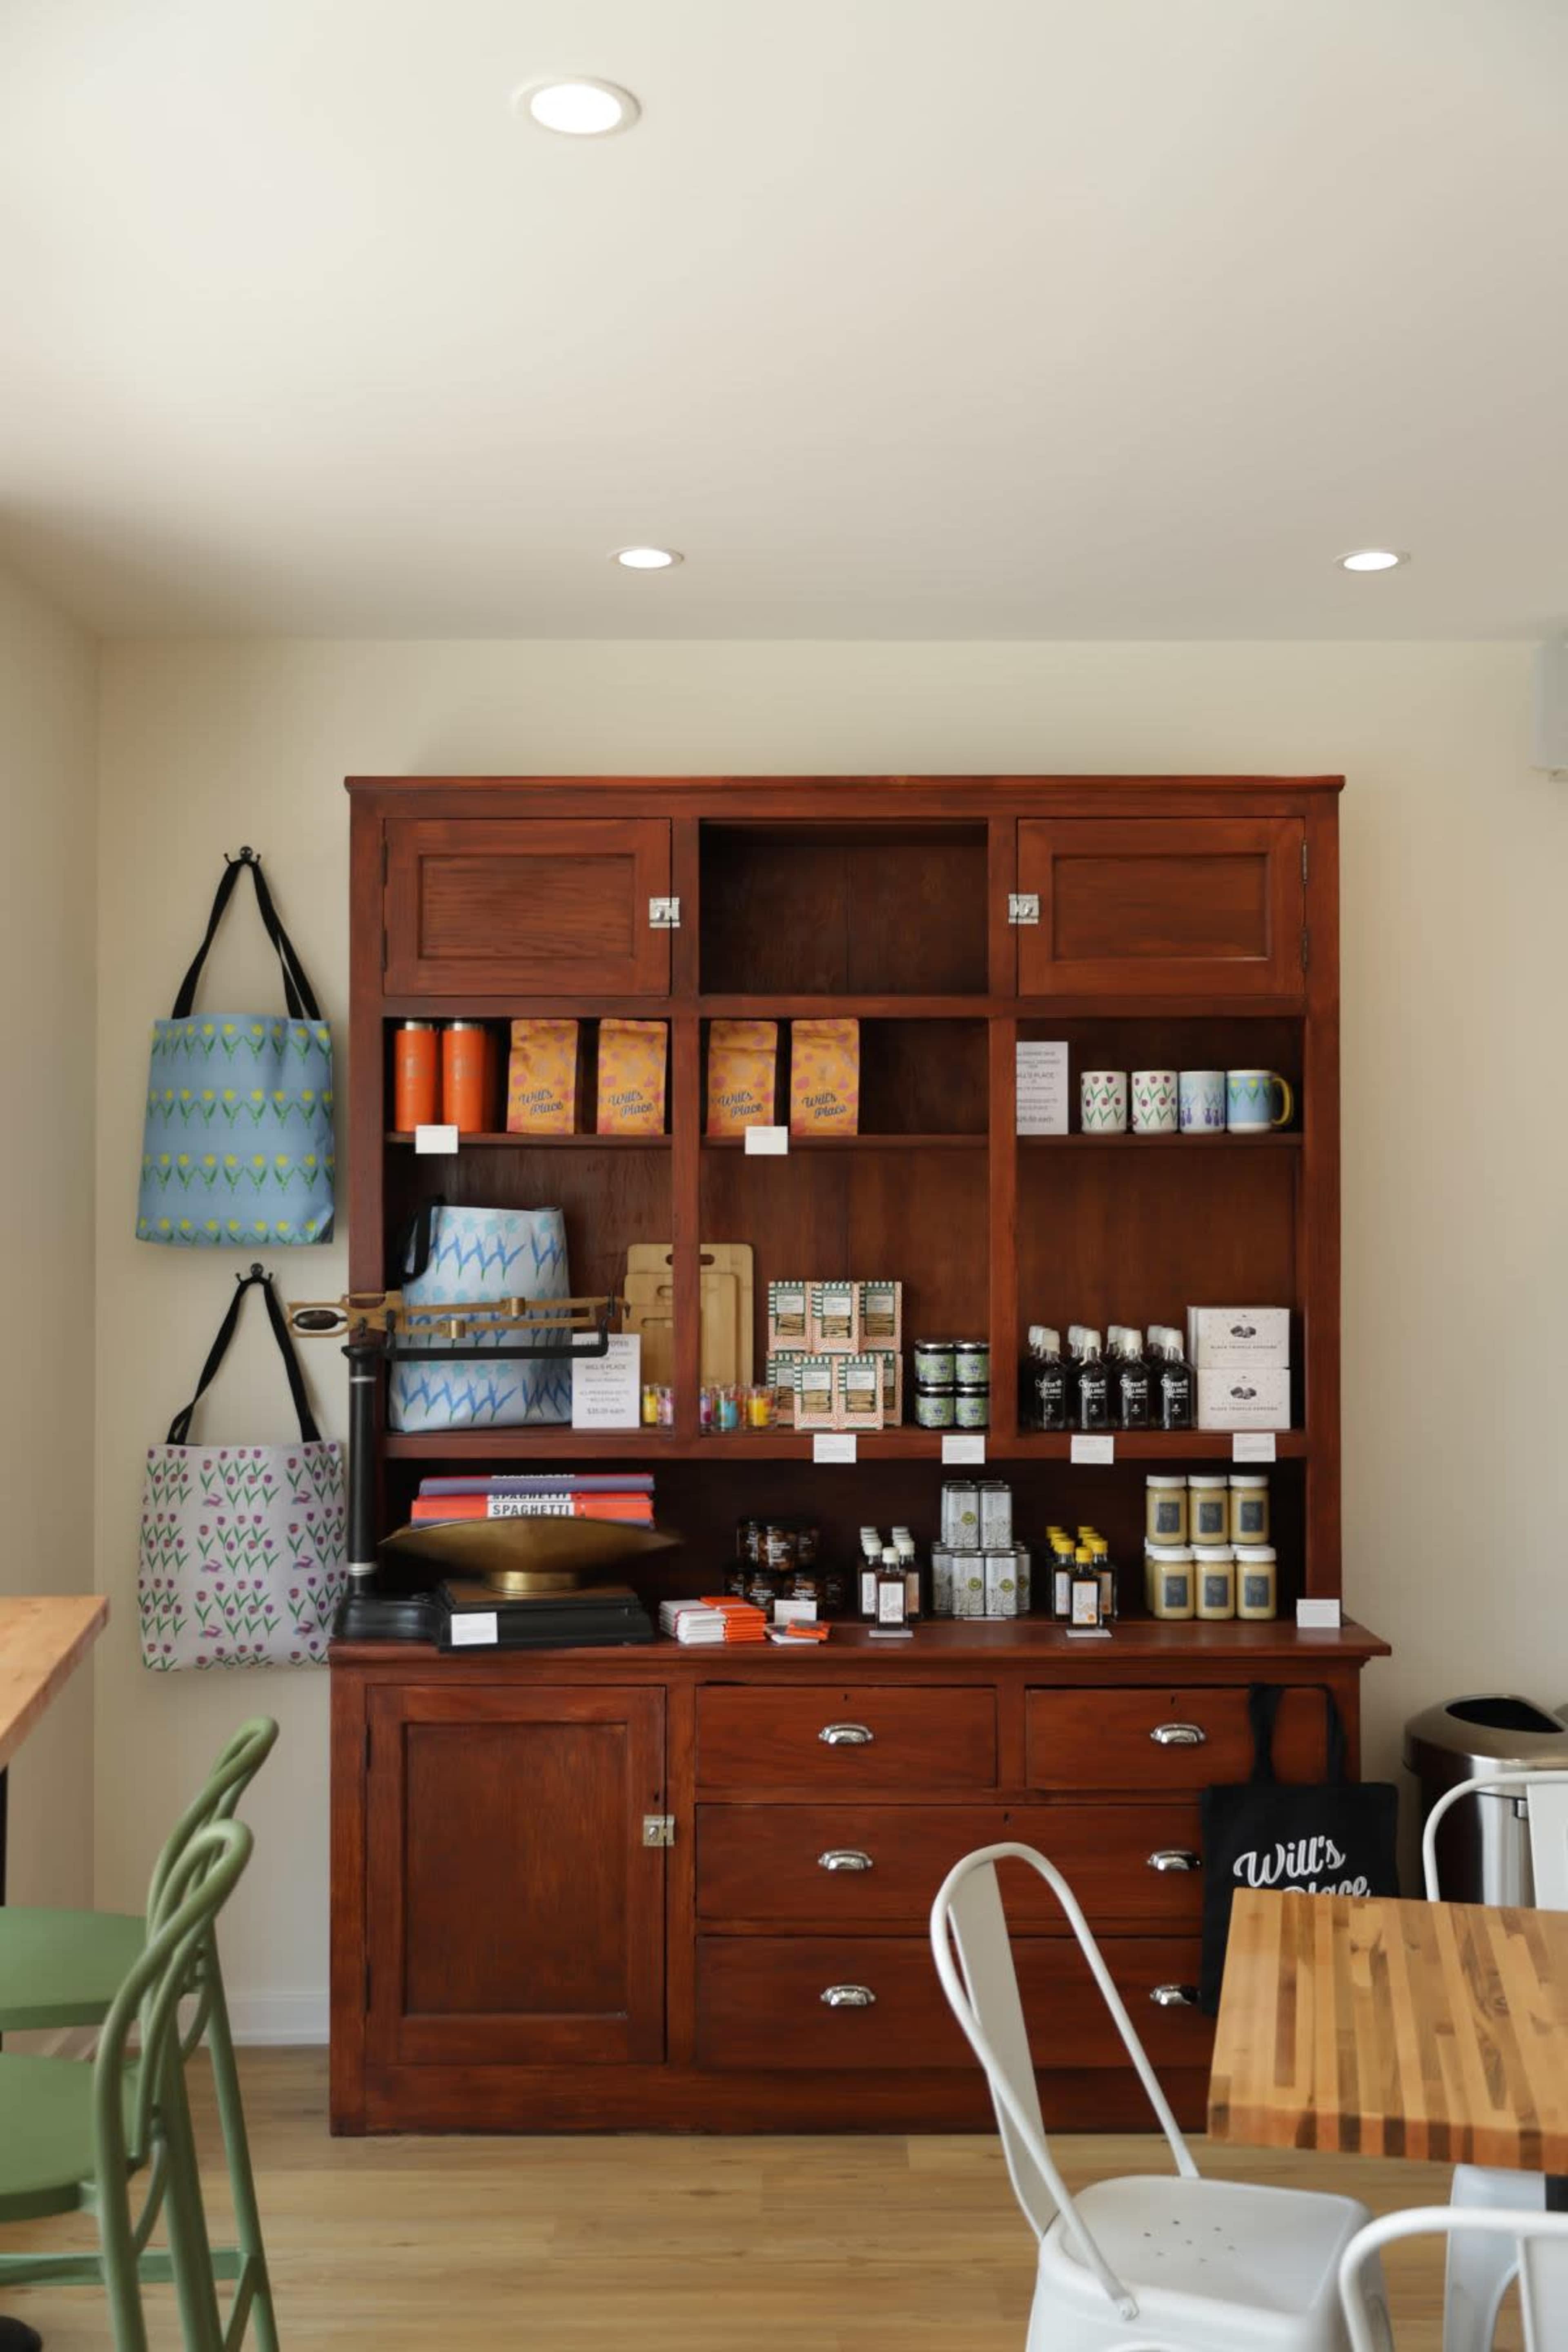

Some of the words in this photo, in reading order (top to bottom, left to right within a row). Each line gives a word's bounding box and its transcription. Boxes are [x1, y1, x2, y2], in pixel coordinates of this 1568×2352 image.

[519, 1089, 553, 1105] Will's
[608, 1089, 644, 1106] Will's
[719, 1091, 753, 1106] Will's
[801, 1092, 837, 1108] Will's
[530, 1100, 564, 1116] Place
[621, 1102, 654, 1118] Place
[731, 1102, 763, 1118] Place
[814, 1103, 847, 1118] Place
[493, 1504, 569, 1515] SPAGHETTI
[1233, 1835, 1346, 1887] Will's
